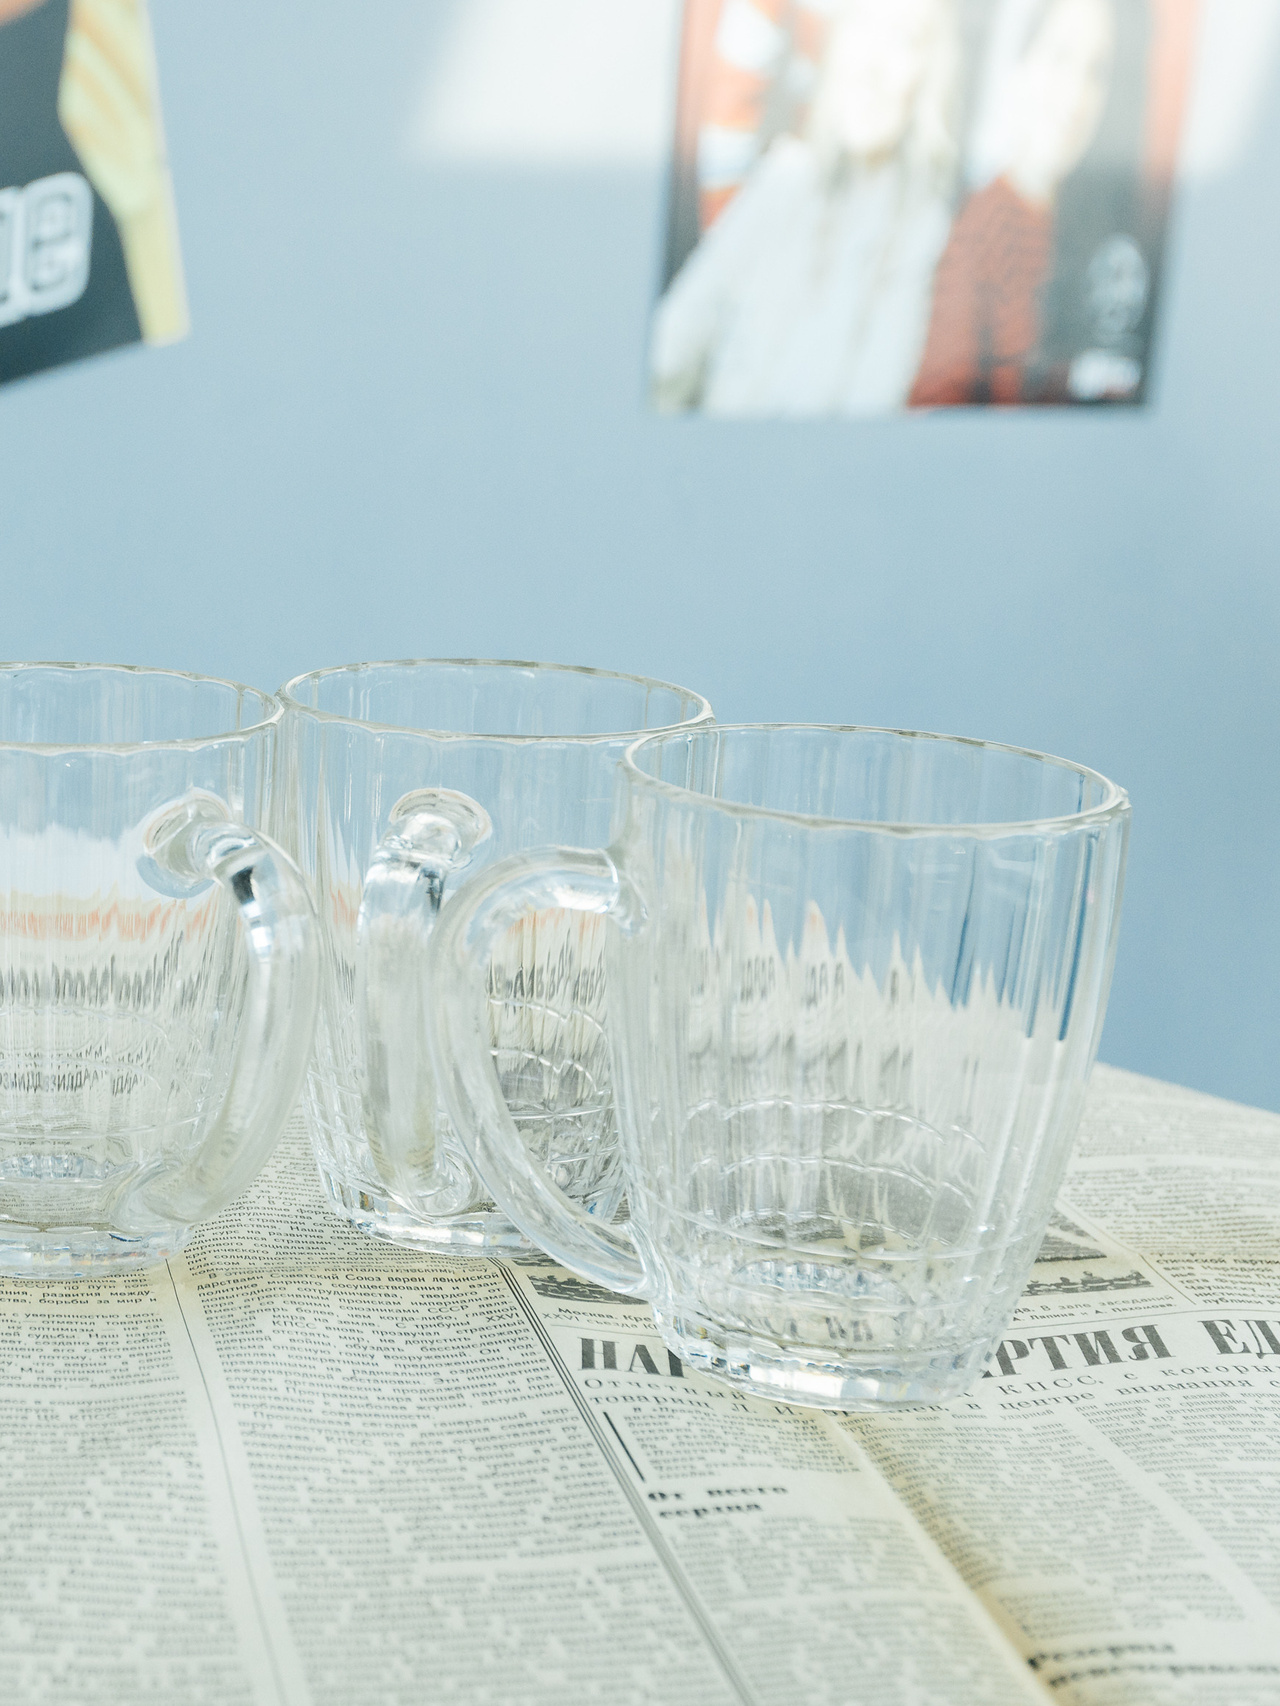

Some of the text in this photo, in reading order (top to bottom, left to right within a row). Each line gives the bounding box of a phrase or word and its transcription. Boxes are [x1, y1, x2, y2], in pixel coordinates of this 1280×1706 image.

[197, 1275, 264, 1291] дарствами
[270, 1272, 500, 1284] Советский Союз верен ленинской
[198, 1283, 258, 1298] политике
[331, 1282, 443, 1292] сосуществования
[297, 1286, 478, 1300] сотрудничества, твердого
[410, 1294, 511, 1307] империализма.
[1058, 1293, 1175, 1311] зале заседаний
[427, 1304, 469, 1314] СССР
[465, 1305, 518, 1318] главной
[558, 1307, 618, 1320] Москва.
[106, 1318, 164, 1326] товарищ
[541, 1312, 580, 1323] XXVI
[28, 1325, 95, 1333] оптимизм
[272, 1319, 526, 1337] КПСС прозвучал страстный
[586, 1319, 638, 1330] съезда
[125, 1330, 167, 1339] народ
[585, 1378, 747, 1400] Отчетный
[997, 1374, 1104, 1397] КПСС,
[1123, 1372, 1138, 1381] с
[966, 1403, 982, 1411] в
[999, 1390, 1096, 1411] центре
[1116, 1379, 1256, 1396] внимания
[731, 1403, 758, 1414] Л.
[774, 1406, 804, 1416] И.
